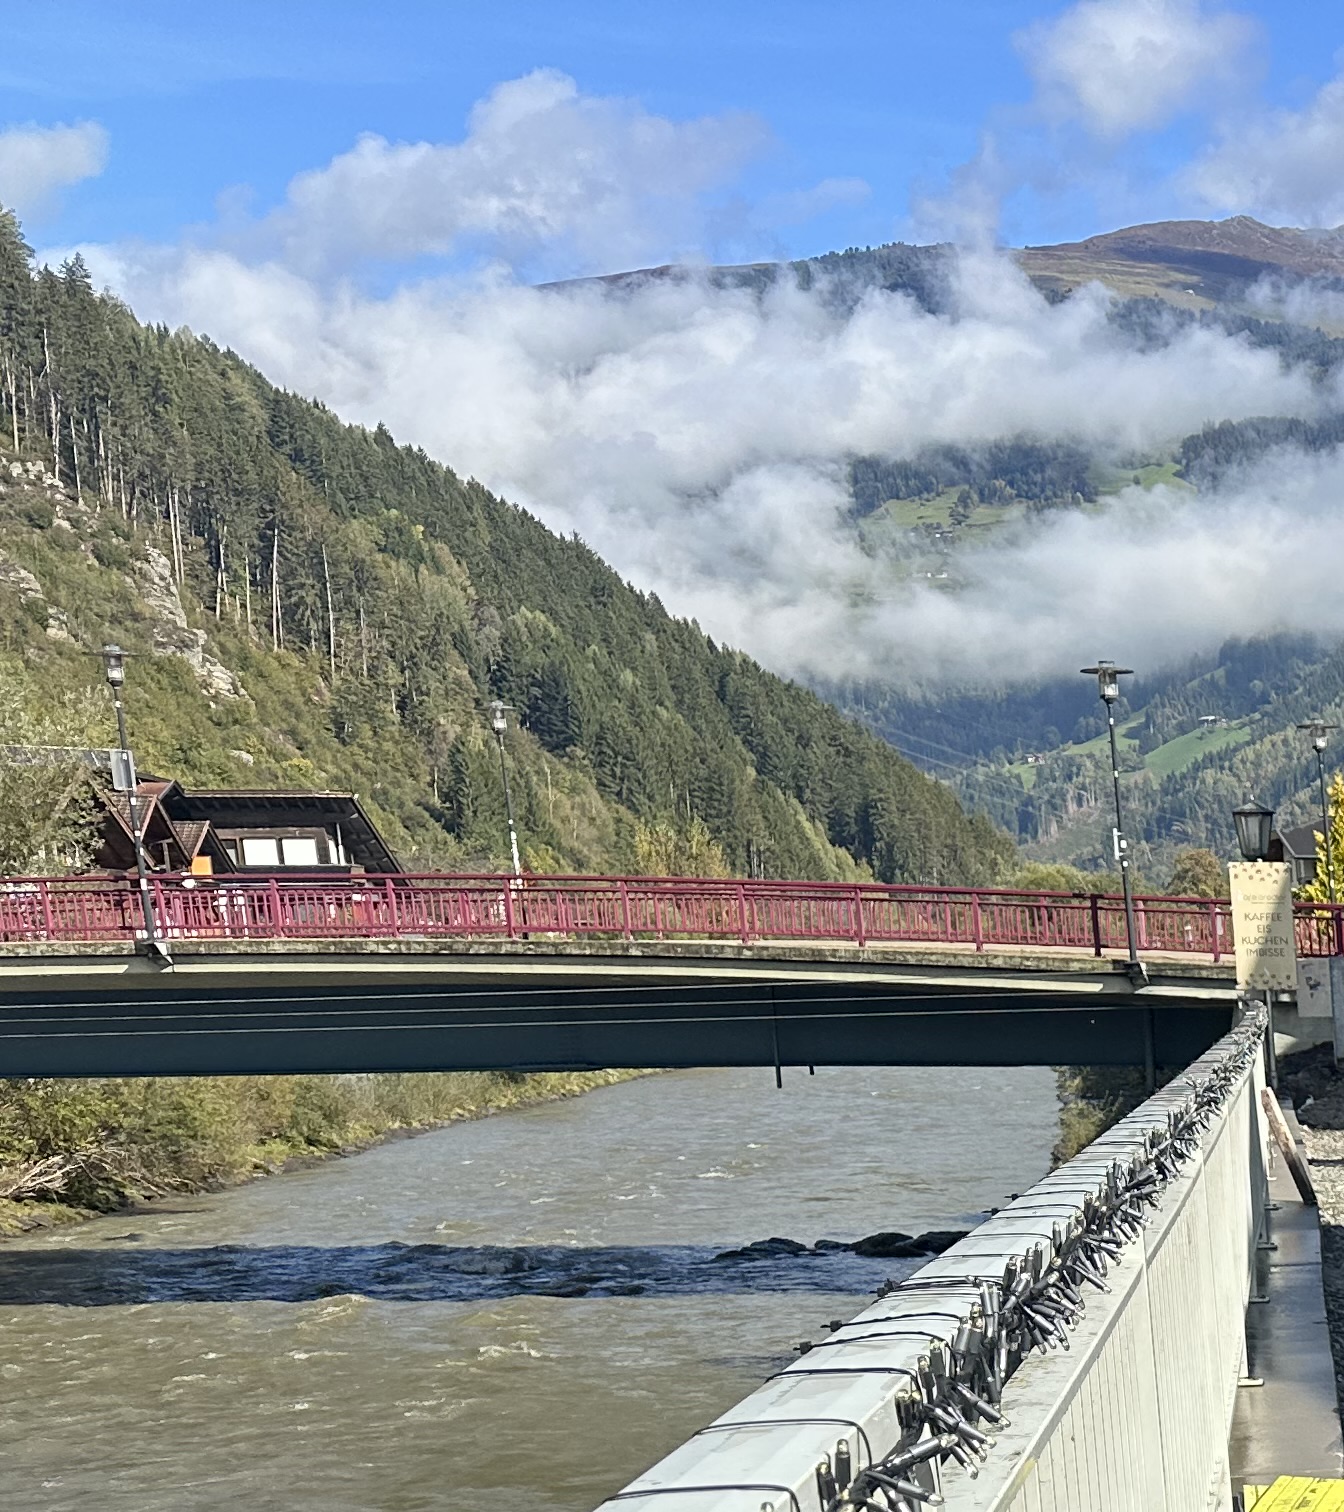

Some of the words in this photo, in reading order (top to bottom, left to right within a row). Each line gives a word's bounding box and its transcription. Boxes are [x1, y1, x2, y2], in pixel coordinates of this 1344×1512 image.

[1243, 911, 1283, 922] KAFFEE
[1256, 924, 1272, 935] EIS
[1241, 935, 1288, 946] KUCHEN
[1246, 947, 1285, 958] IMBISSE
